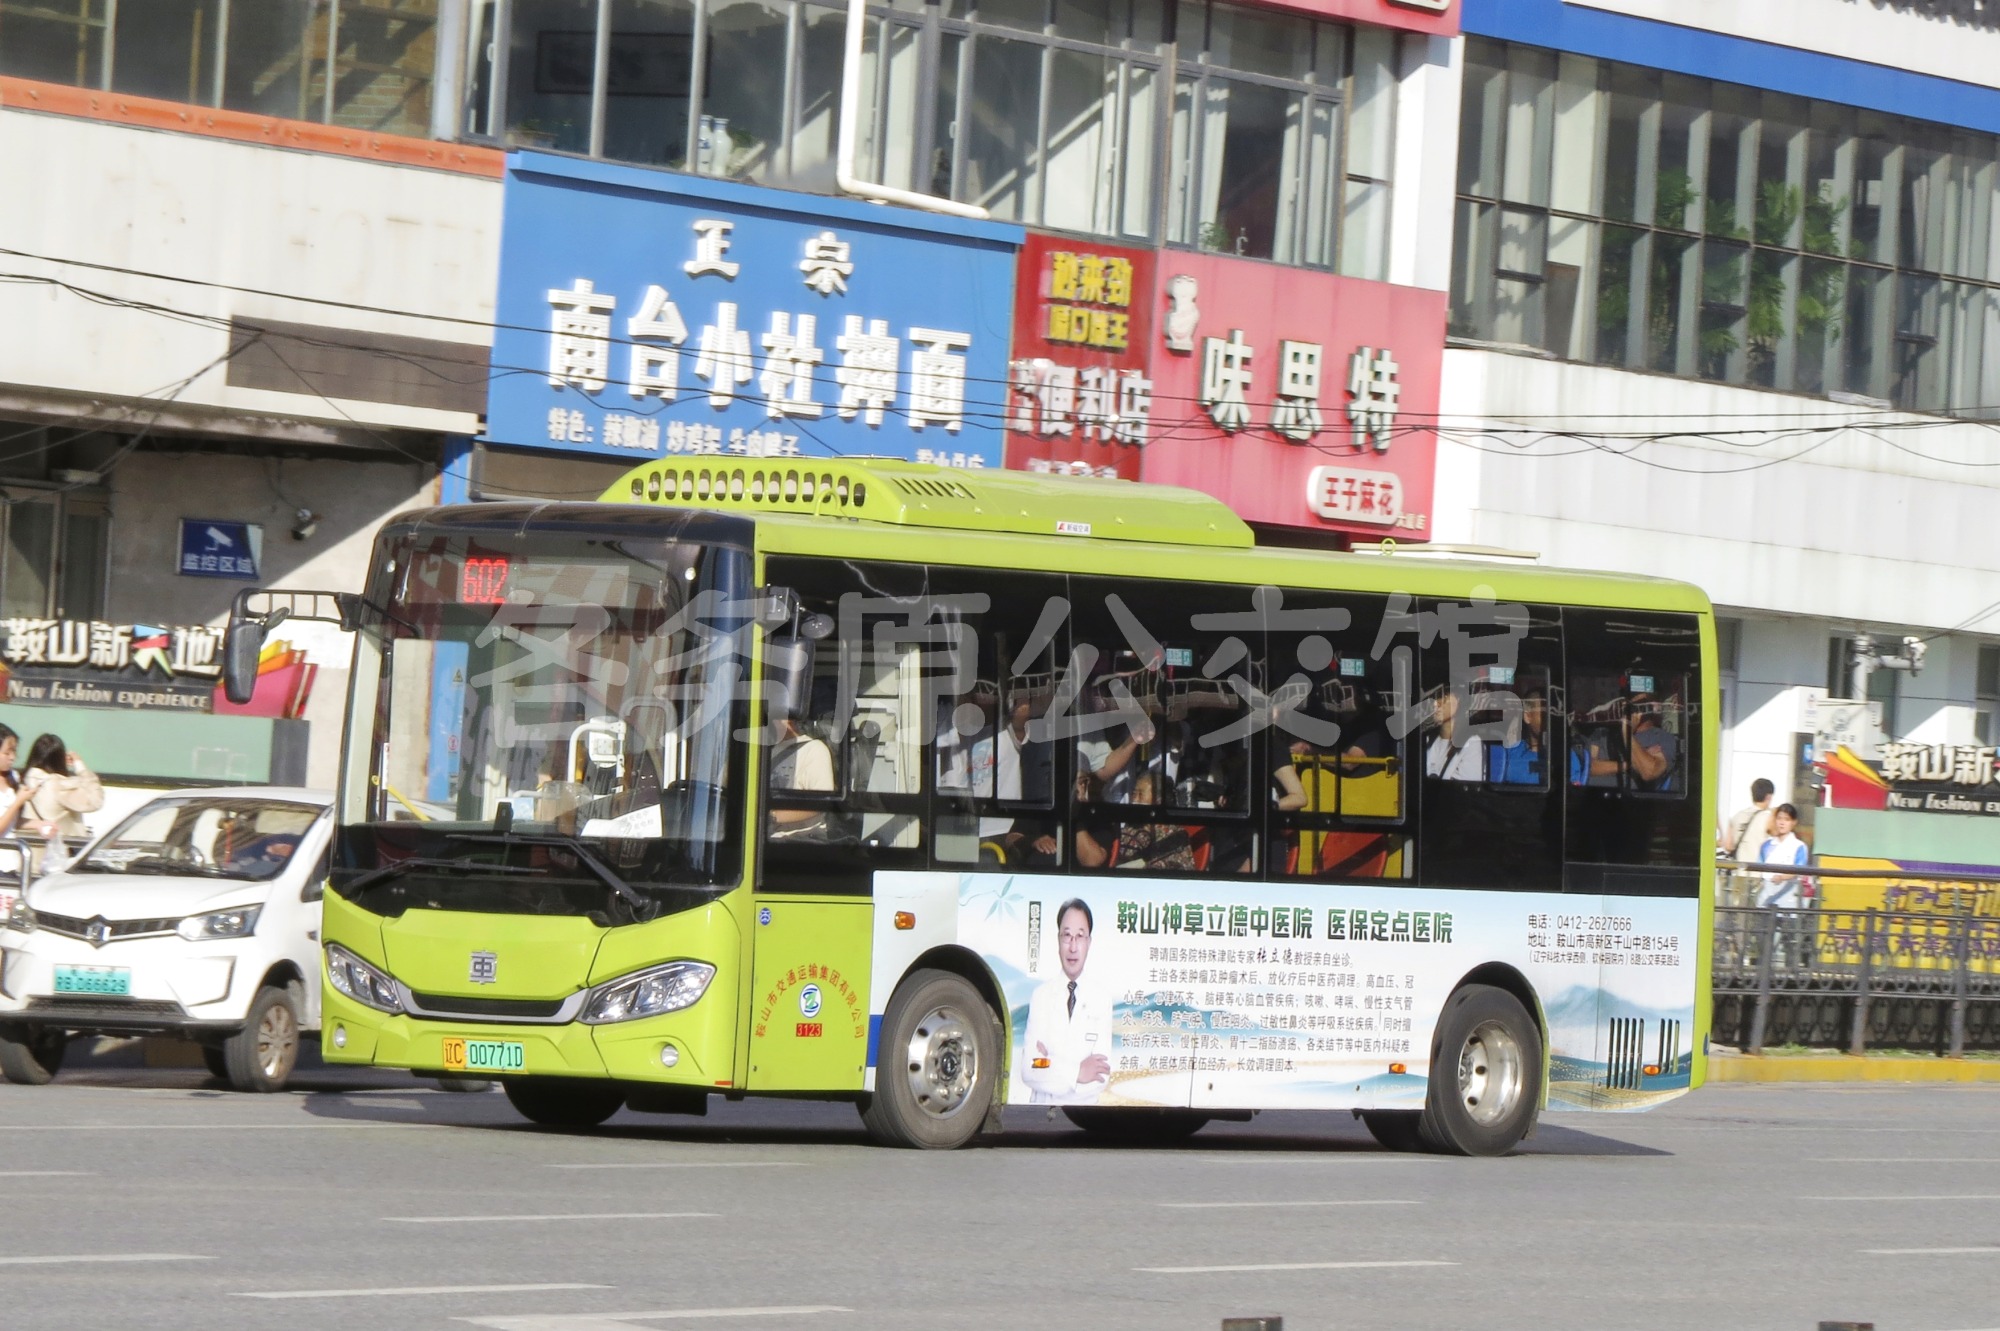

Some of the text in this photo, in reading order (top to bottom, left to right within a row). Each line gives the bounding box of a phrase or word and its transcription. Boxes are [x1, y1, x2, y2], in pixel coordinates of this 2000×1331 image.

[684, 219, 853, 297] 正宗
[1201, 329, 1400, 454] 味思特
[1323, 477, 1395, 516] 王子麻花
[182, 553, 253, 574] 监控区域
[462, 557, 509, 604] 602
[1875, 743, 2000, 786] 鞍山新
[1117, 901, 1453, 944] 鞍山神草立德中医院 医保定点医院
[755, 963, 865, 1038] 鞍山市交通运输集团有限公司
[797, 1023, 822, 1037] 3123
